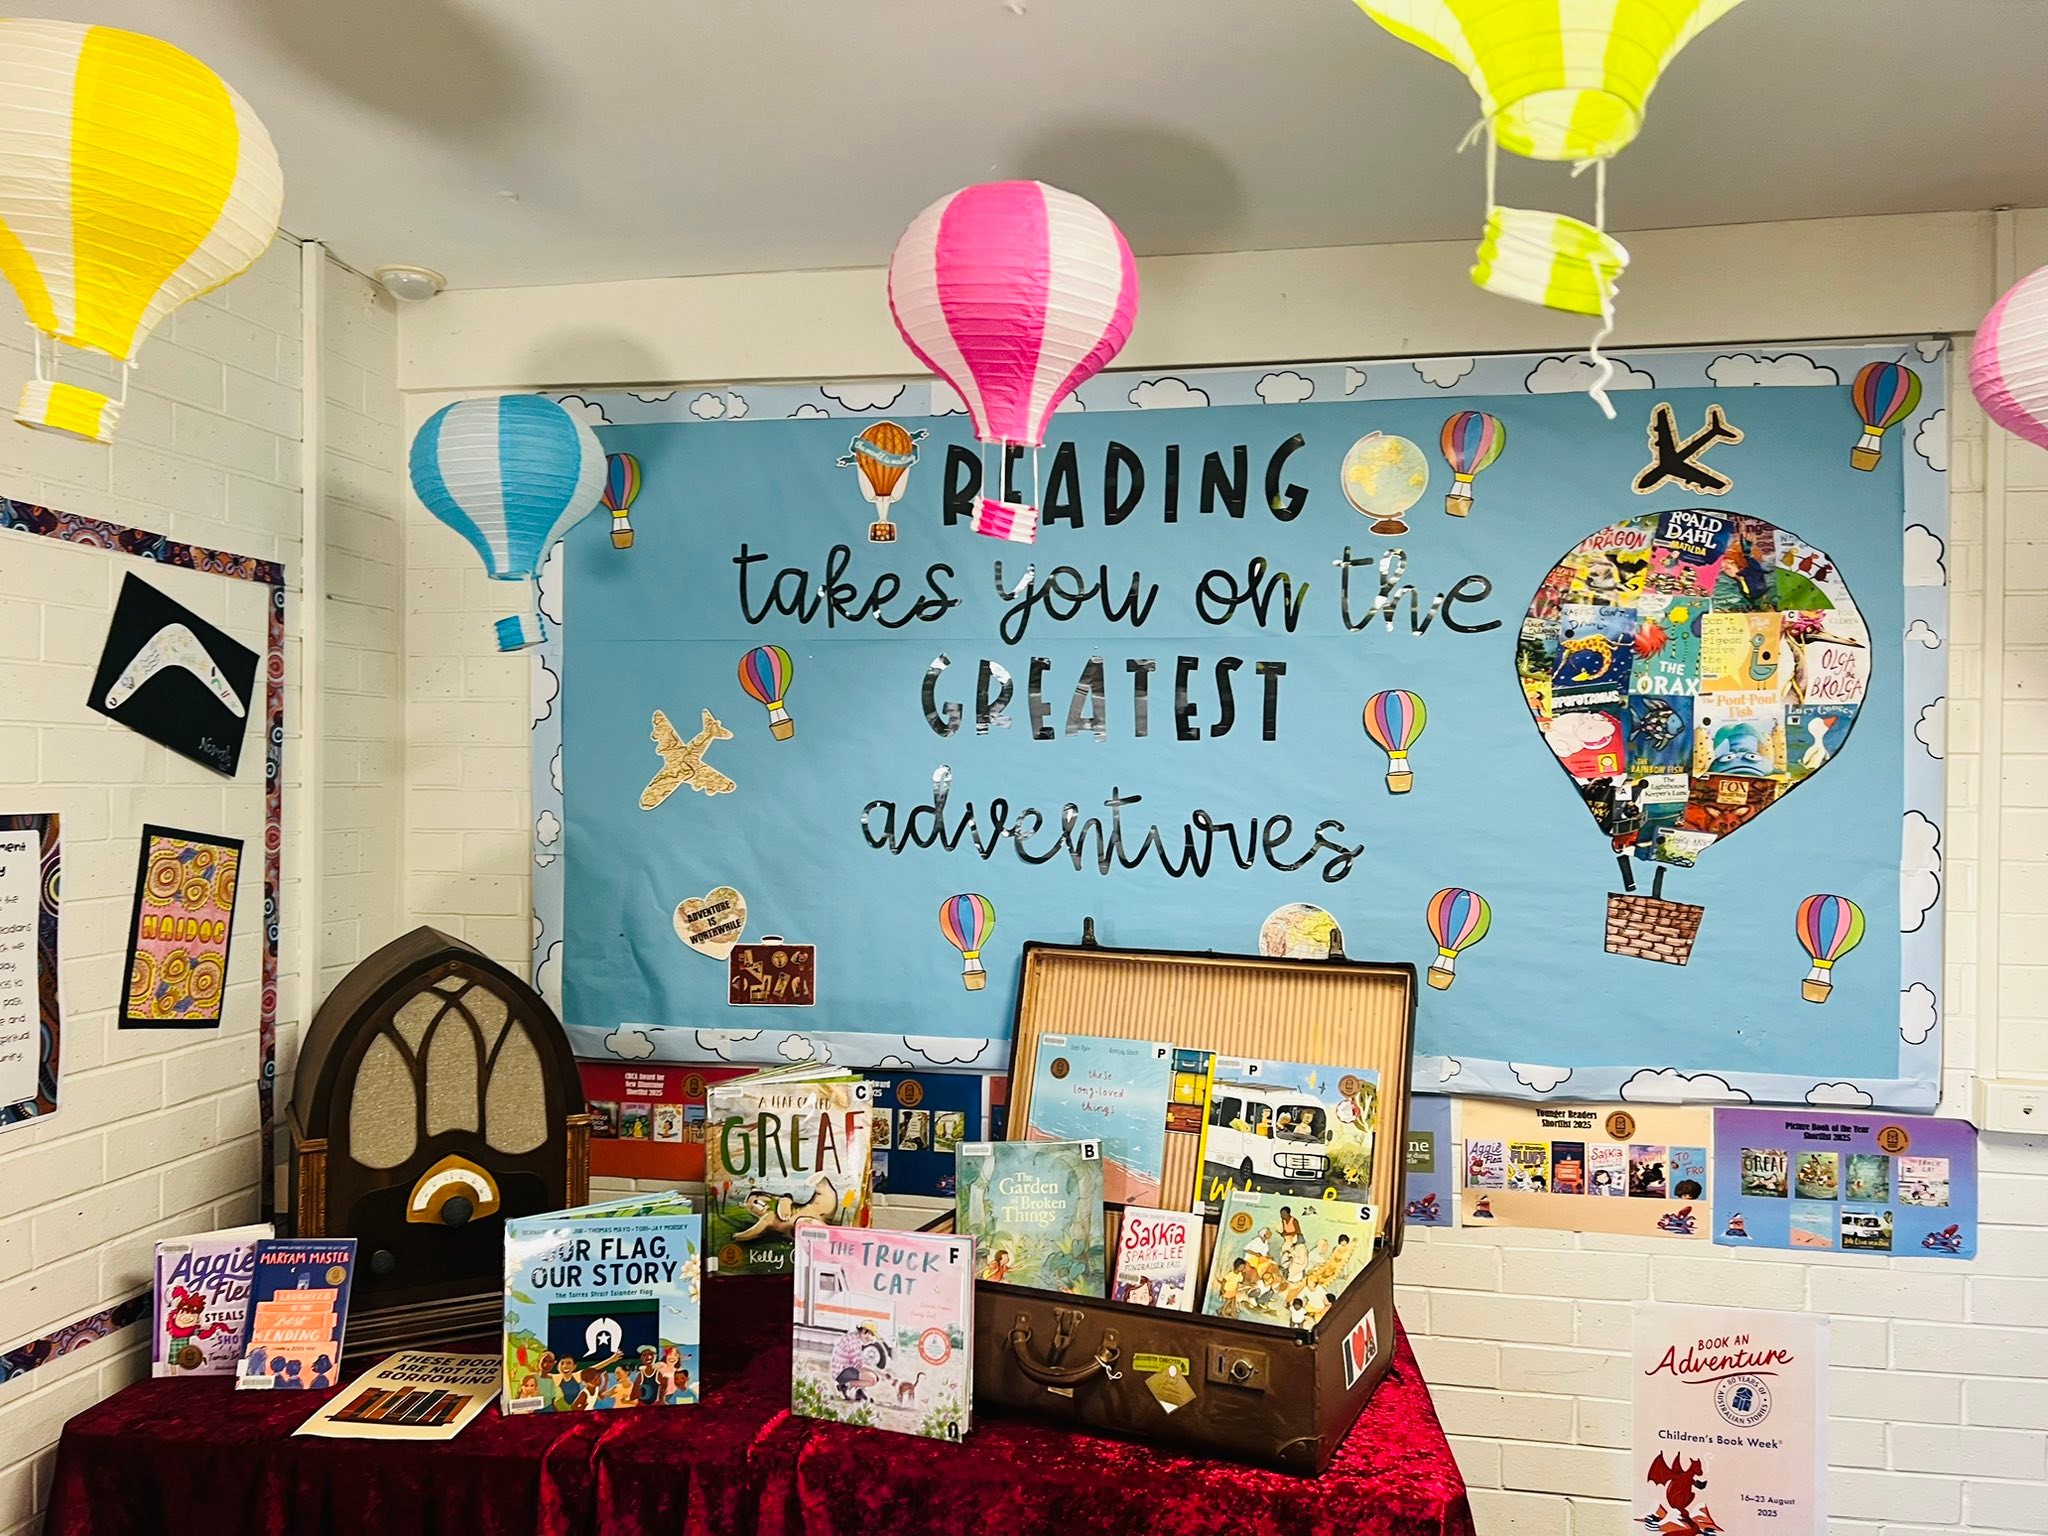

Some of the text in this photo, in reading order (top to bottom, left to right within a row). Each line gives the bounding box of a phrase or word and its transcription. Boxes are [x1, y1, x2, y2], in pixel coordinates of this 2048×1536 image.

[942, 433, 1309, 528] READING
[1669, 511, 1722, 533] ROALD
[1664, 523, 1717, 549] DAHL
[732, 543, 1502, 645] takes you on the
[1660, 661, 1686, 675] THE
[921, 653, 1287, 742] GREATEST
[1720, 781, 1747, 793] FOX
[860, 764, 1365, 883] adventures
[687, 901, 731, 924] ADVENTURE
[707, 916, 717, 927] IS
[141, 914, 226, 945] NAIDOC
[689, 919, 741, 945] WORTHWHILE
[1158, 1049, 1166, 1058] P
[1088, 1070, 1112, 1080] these
[1250, 1065, 1258, 1075] P
[855, 1085, 866, 1099] C
[1073, 1084, 1125, 1099] long-loved
[758, 1096, 793, 1109] A LEAF
[1081, 1102, 1115, 1116] things
[1536, 1109, 1597, 1119] Younger Readers
[1542, 1119, 1591, 1129] Shortlist 2025
[1785, 1122, 1810, 1131] Picture
[1812, 1123, 1829, 1131] Book
[1085, 1144, 1095, 1158] B
[1470, 1142, 1502, 1158] Aggie
[1511, 1150, 1547, 1164] FLUFF
[1675, 1152, 1690, 1161] TO
[1016, 1172, 1033, 1182] The
[1686, 1166, 1704, 1176] FRO
[999, 1178, 1058, 1195] Garden
[1021, 1196, 1066, 1210] Broken
[1001, 1206, 1056, 1228] Things
[1360, 1207, 1370, 1220] S
[1125, 1219, 1186, 1250] Saskia
[601, 1235, 670, 1261] FLAG,
[1125, 1246, 1184, 1263] SPARK-LEE
[260, 1252, 349, 1264] MARYAM MASTER
[749, 1249, 785, 1270] Kelly
[830, 1241, 941, 1273] THE TRUCK
[950, 1248, 959, 1264] F
[167, 1247, 255, 1293] Aggie
[531, 1261, 678, 1289] OUR STORY
[873, 1272, 916, 1296] CAT
[569, 1291, 588, 1299] Torres
[590, 1290, 609, 1298] Strait
[611, 1289, 638, 1297] Islander
[639, 1288, 653, 1297] Flag
[204, 1310, 244, 1323] STEALS
[264, 1328, 319, 1341] ENDING
[1698, 1333, 1749, 1350] BOOK AN
[399, 1355, 453, 1366] THESE
[1645, 1345, 1794, 1376] Adventure
[394, 1364, 499, 1375] ARE NOT FOR
[376, 1370, 497, 1385] BORROWING
[1737, 1375, 1759, 1389] YEARS
[1758, 1386, 1767, 1396] OF
[1717, 1390, 1769, 1424] AUSTRALIAN STORIES
[1658, 1429, 1713, 1444] Children's
[1716, 1435, 1744, 1446] Book
[1767, 1496, 1796, 1506] August
[1757, 1508, 1778, 1518] 2025
